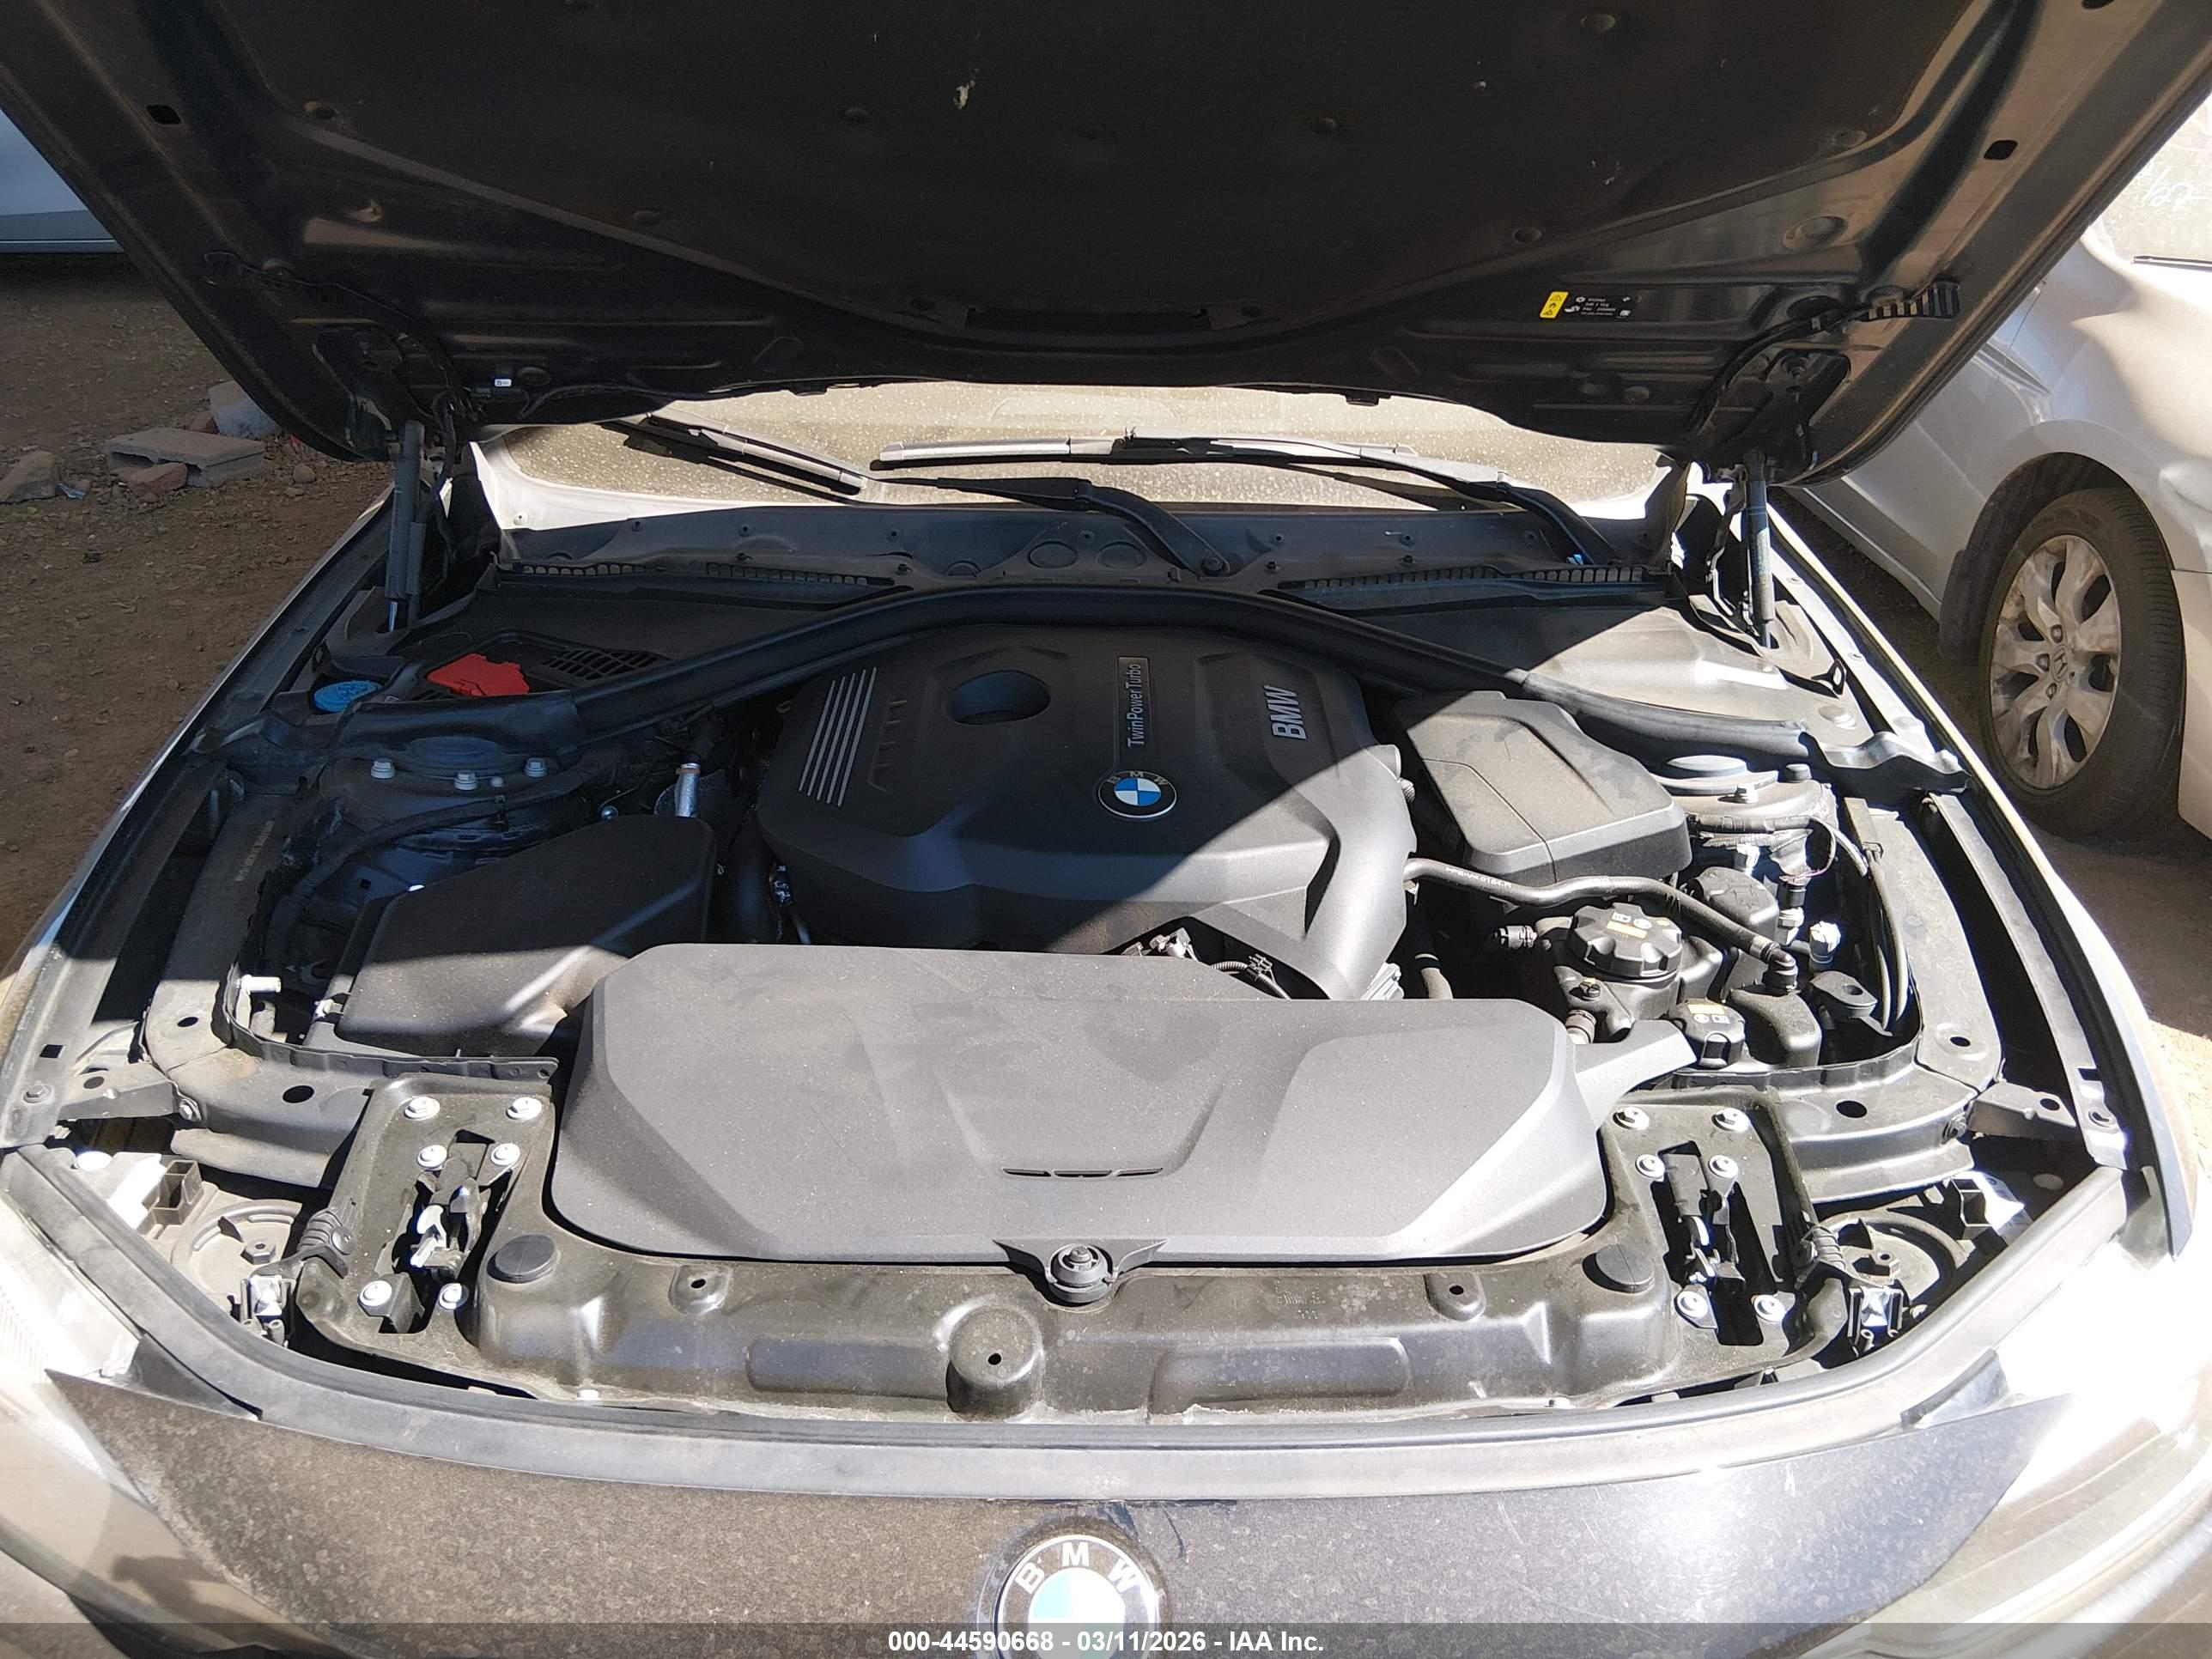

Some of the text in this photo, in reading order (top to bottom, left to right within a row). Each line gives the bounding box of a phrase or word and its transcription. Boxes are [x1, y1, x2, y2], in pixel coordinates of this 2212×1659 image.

[1125, 664, 1145, 748] TwinPower Turbo
[1264, 684, 1306, 738] BMW
[1107, 770, 1169, 785] BMW
[1015, 1541, 1139, 1595] BMW
